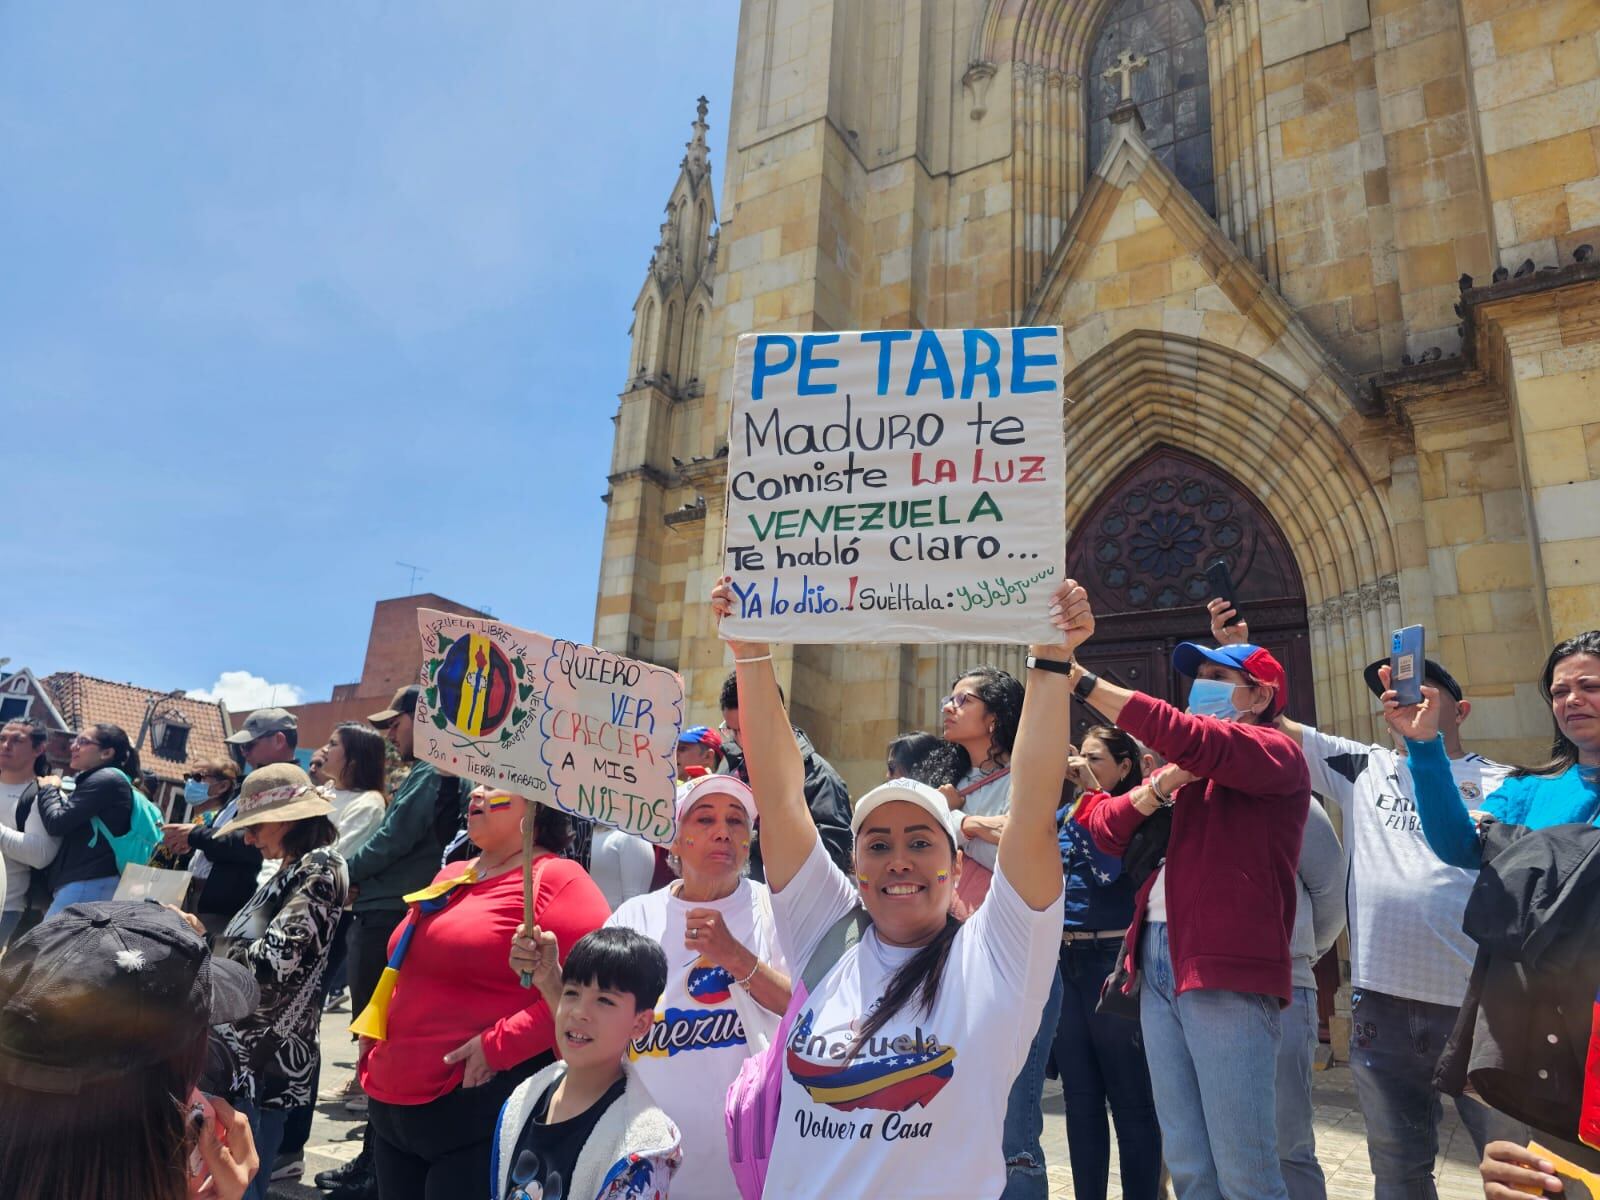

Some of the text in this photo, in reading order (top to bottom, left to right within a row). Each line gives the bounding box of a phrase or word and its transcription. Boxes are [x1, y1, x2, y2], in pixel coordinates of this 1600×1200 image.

[967, 402, 1025, 445] te
[911, 452, 957, 485] LA
[748, 490, 1003, 541] VENEZUELA
[727, 545, 765, 571] Te
[776, 537, 860, 569] habló
[770, 576, 789, 615] lo
[559, 641, 641, 690] QUIERO
[417, 695, 429, 724] POR
[611, 692, 655, 735] VER
[552, 709, 655, 766] CRECER
[500, 763, 547, 790] TRABAJO
[561, 751, 638, 785] A MIS
[794, 1109, 933, 1141] Volver a Casa
